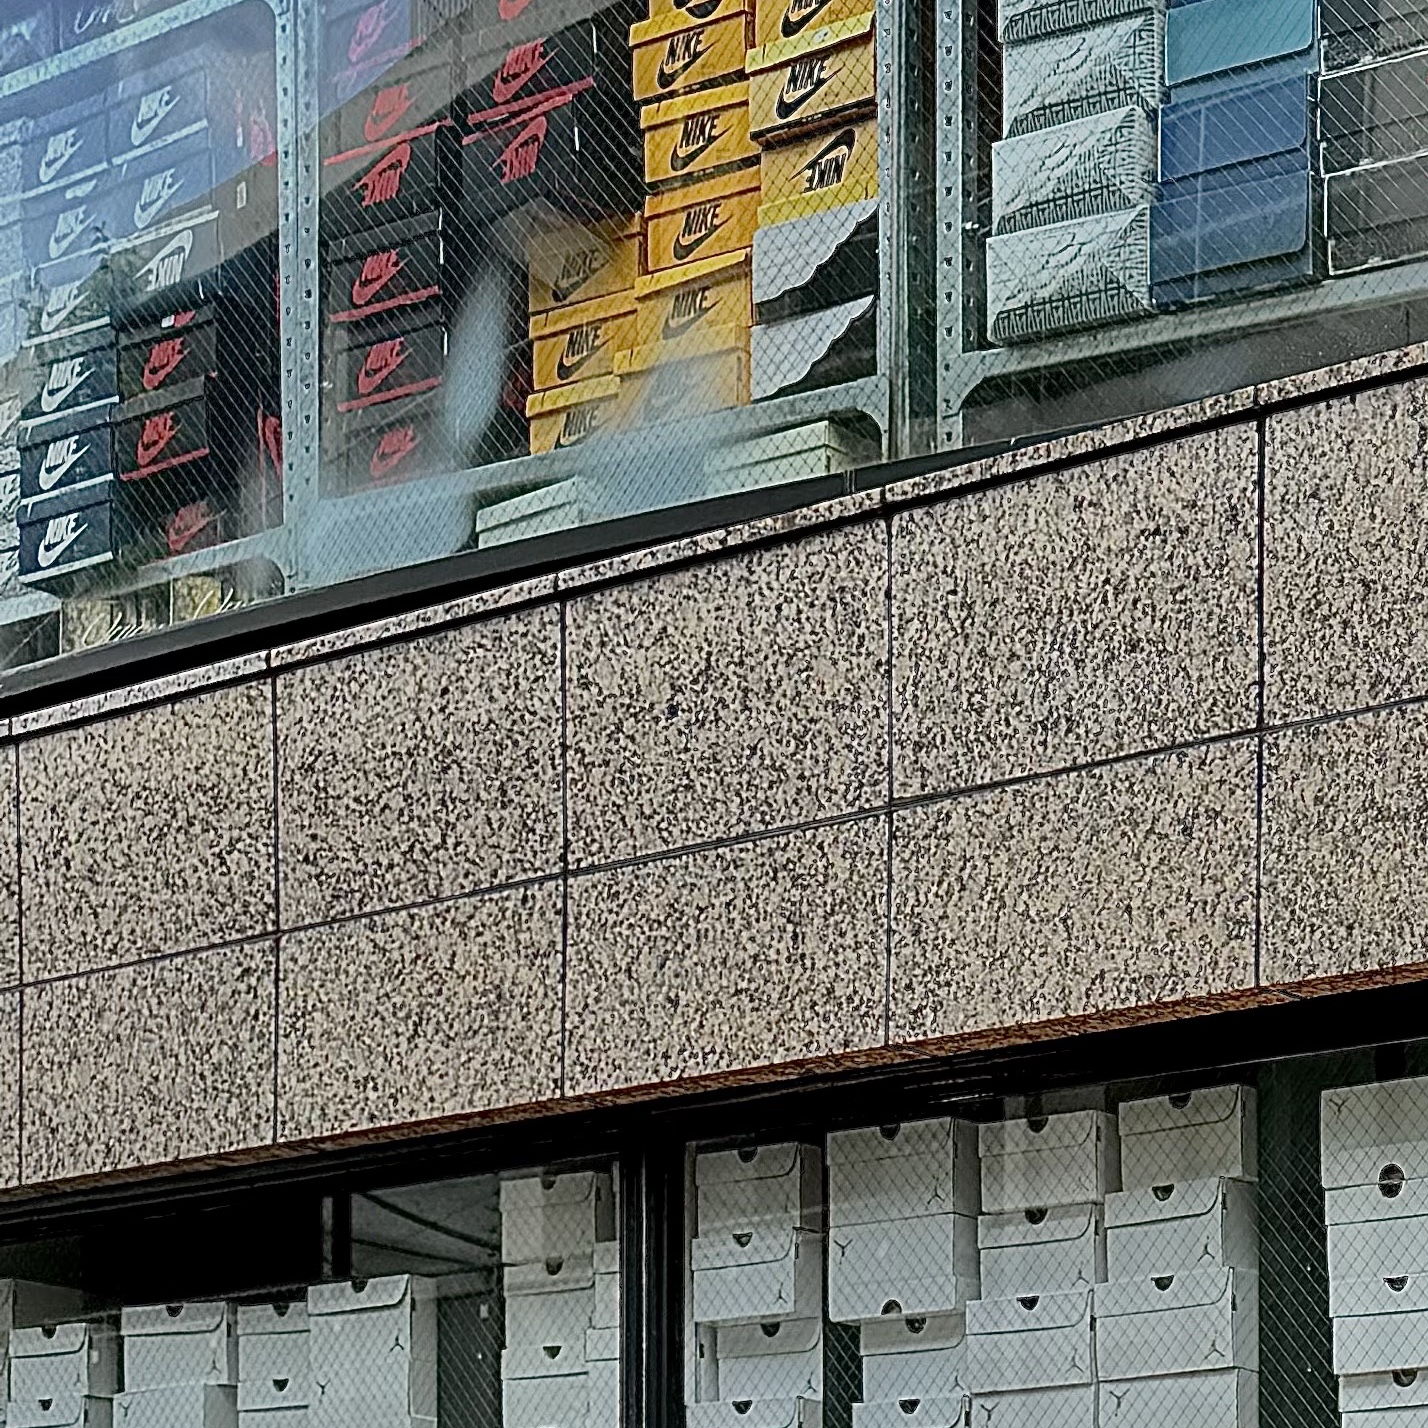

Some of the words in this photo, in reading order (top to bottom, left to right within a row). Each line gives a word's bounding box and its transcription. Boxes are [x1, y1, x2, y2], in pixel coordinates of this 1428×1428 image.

[665, 29, 705, 67] NIKE
[785, 54, 832, 95] NIKE
[679, 114, 720, 150] NIKE
[802, 152, 847, 194] NIKE
[682, 203, 721, 238] NIKE
[670, 287, 711, 321] NIKE
[566, 325, 602, 359] NIKE
[49, 357, 84, 389] NIKE
[563, 407, 600, 438] NIKE
[45, 435, 80, 467] NIKE
[44, 513, 79, 545] NIKE
